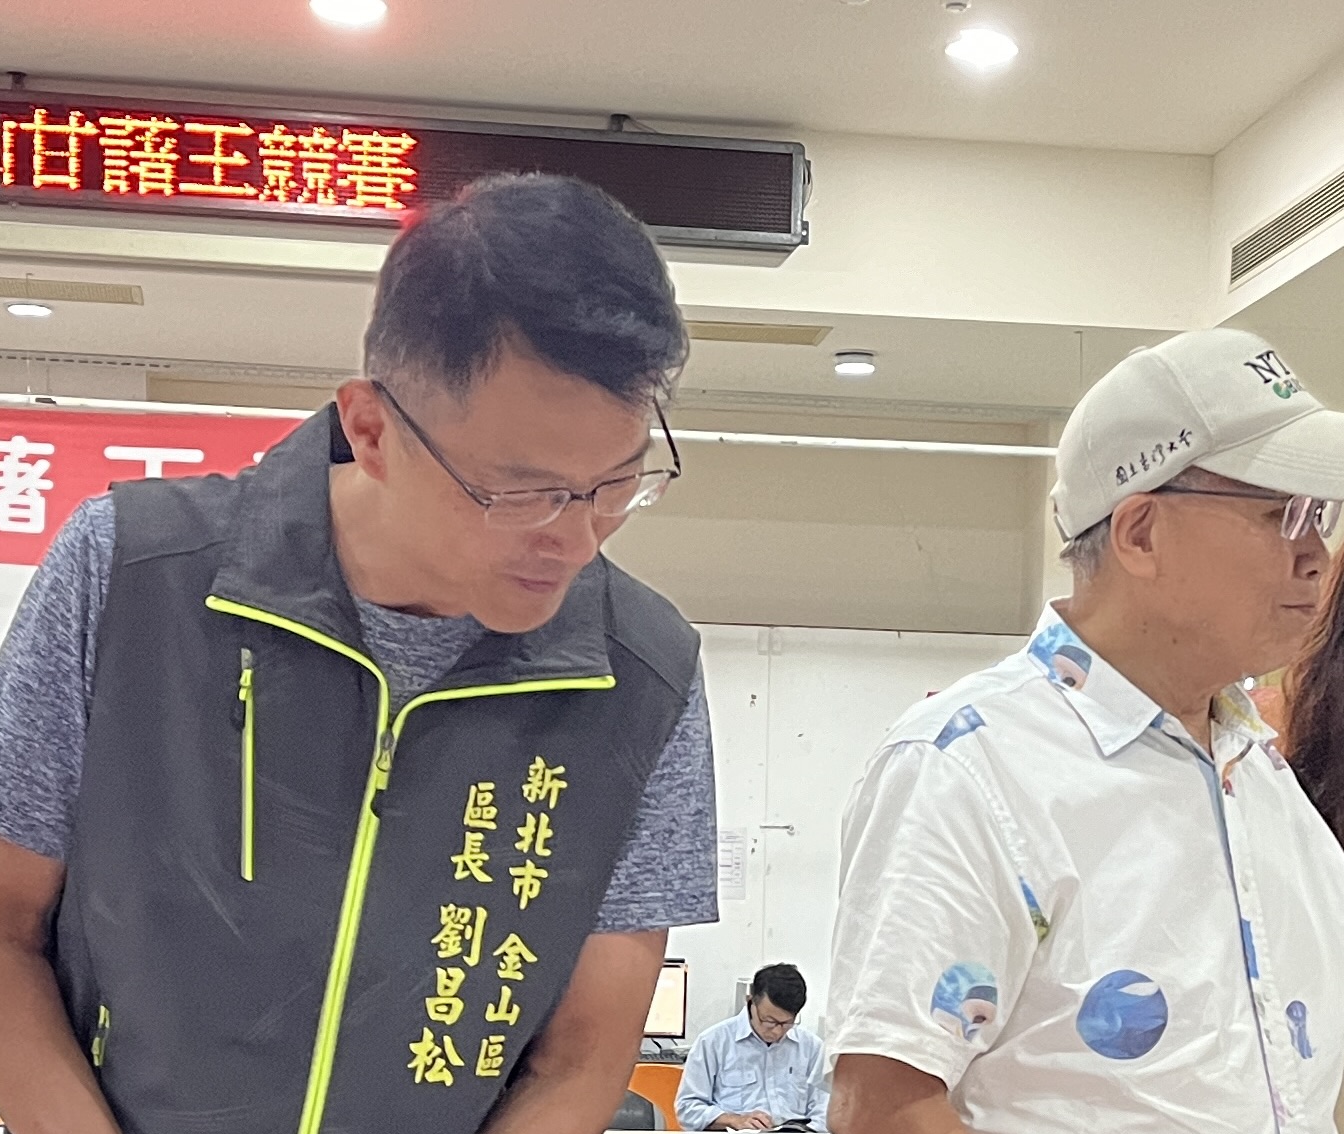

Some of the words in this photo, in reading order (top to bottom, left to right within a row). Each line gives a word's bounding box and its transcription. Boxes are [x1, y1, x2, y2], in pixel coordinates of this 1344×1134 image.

[450, 782, 498, 883] 區長
[508, 755, 568, 910] 新北市
[407, 903, 488, 1087] 劉昌松
[475, 932, 538, 1078] 金山區
